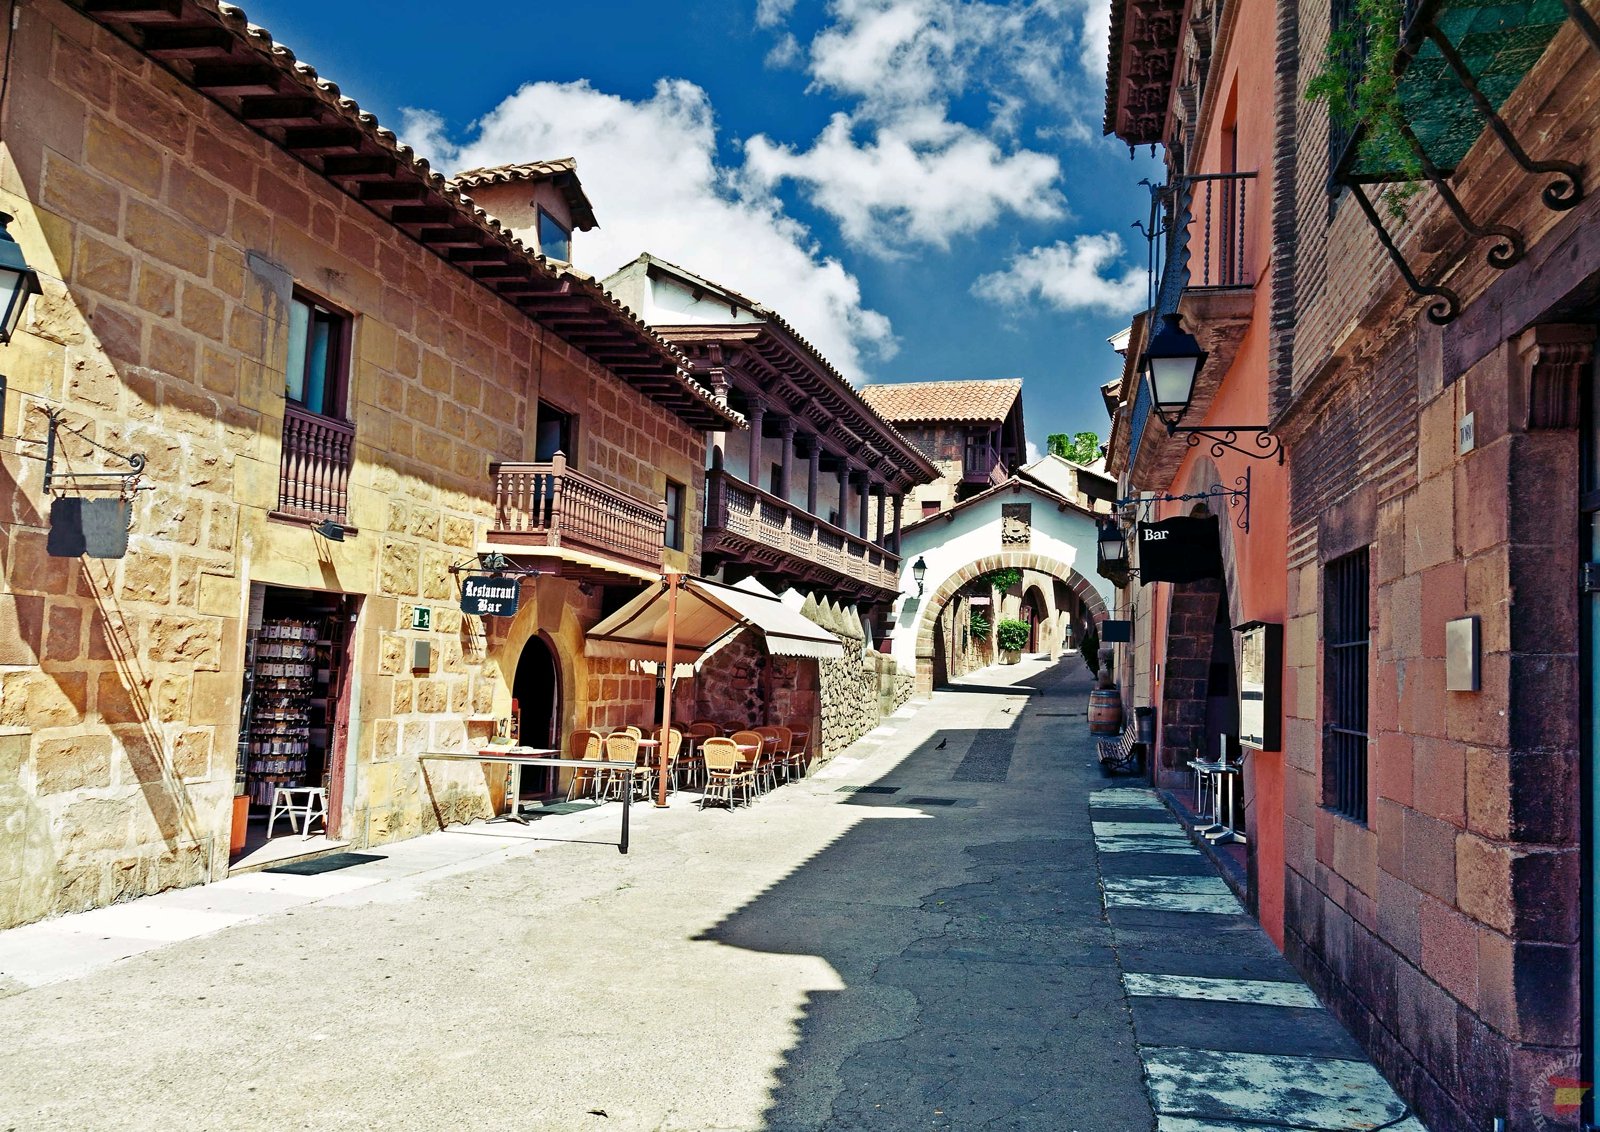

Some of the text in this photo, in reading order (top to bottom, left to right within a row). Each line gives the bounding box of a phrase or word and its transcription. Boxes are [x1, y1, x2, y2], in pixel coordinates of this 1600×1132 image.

[1143, 528, 1170, 541] Bar
[465, 580, 516, 599] Restaurant
[477, 598, 502, 613] Bar
